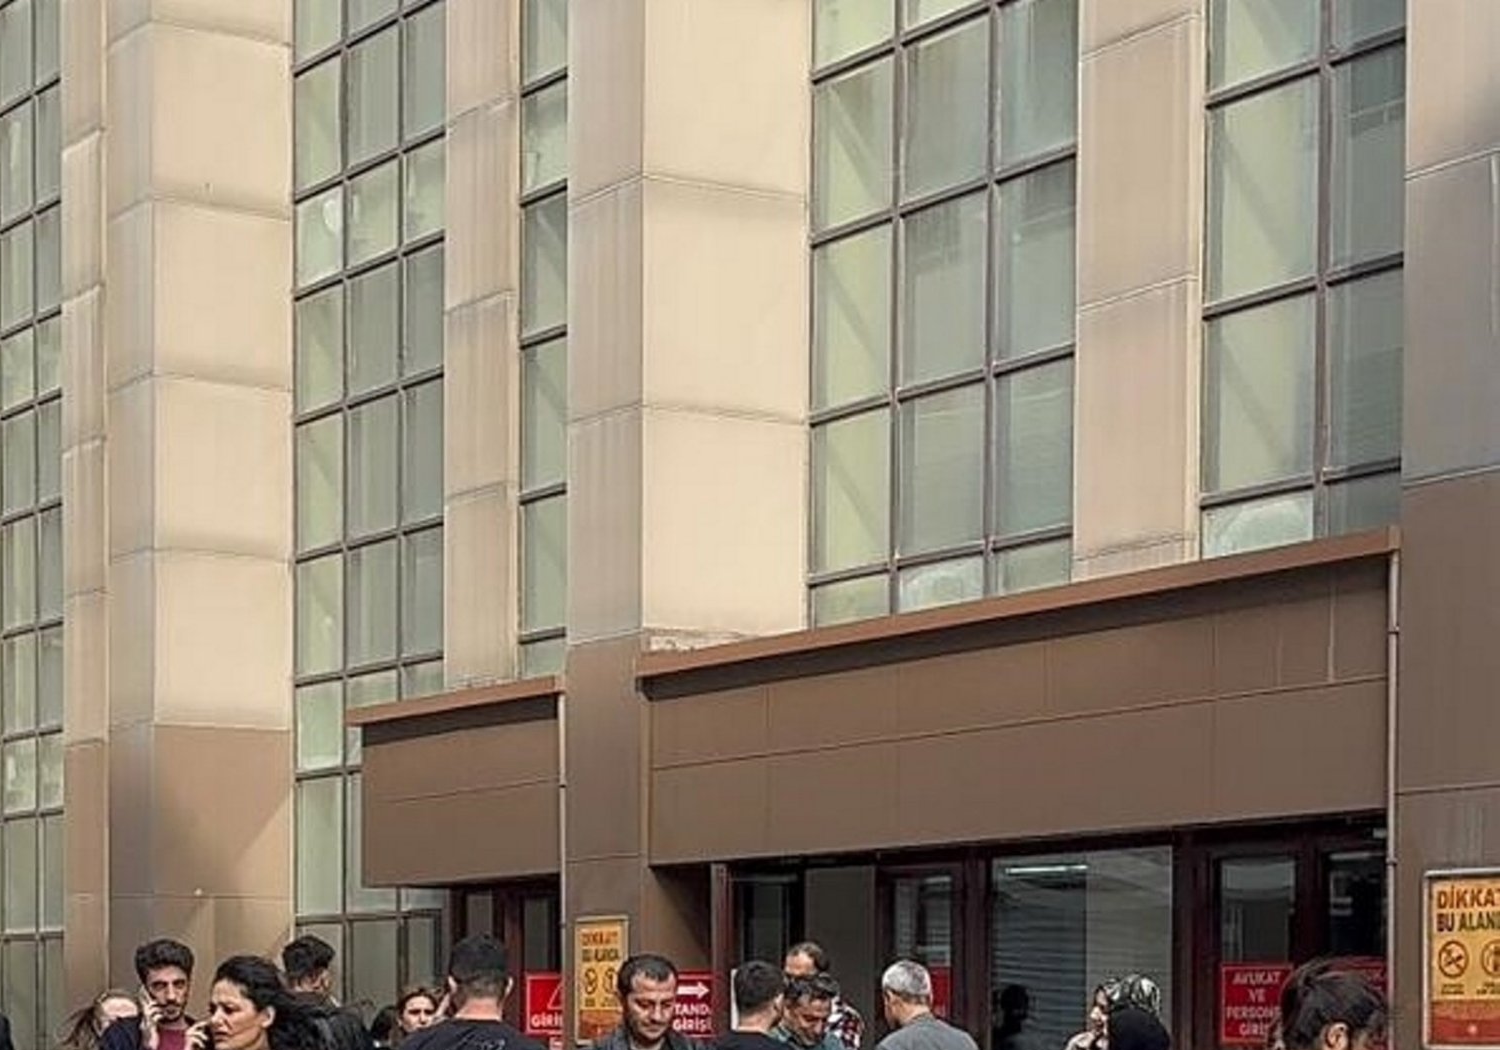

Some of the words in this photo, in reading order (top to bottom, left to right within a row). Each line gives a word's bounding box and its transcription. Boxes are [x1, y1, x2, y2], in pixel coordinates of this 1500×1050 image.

[1436, 912, 1455, 932] BU
[1232, 971, 1282, 985] AVUKAT
[1247, 988, 1266, 1002] VE
